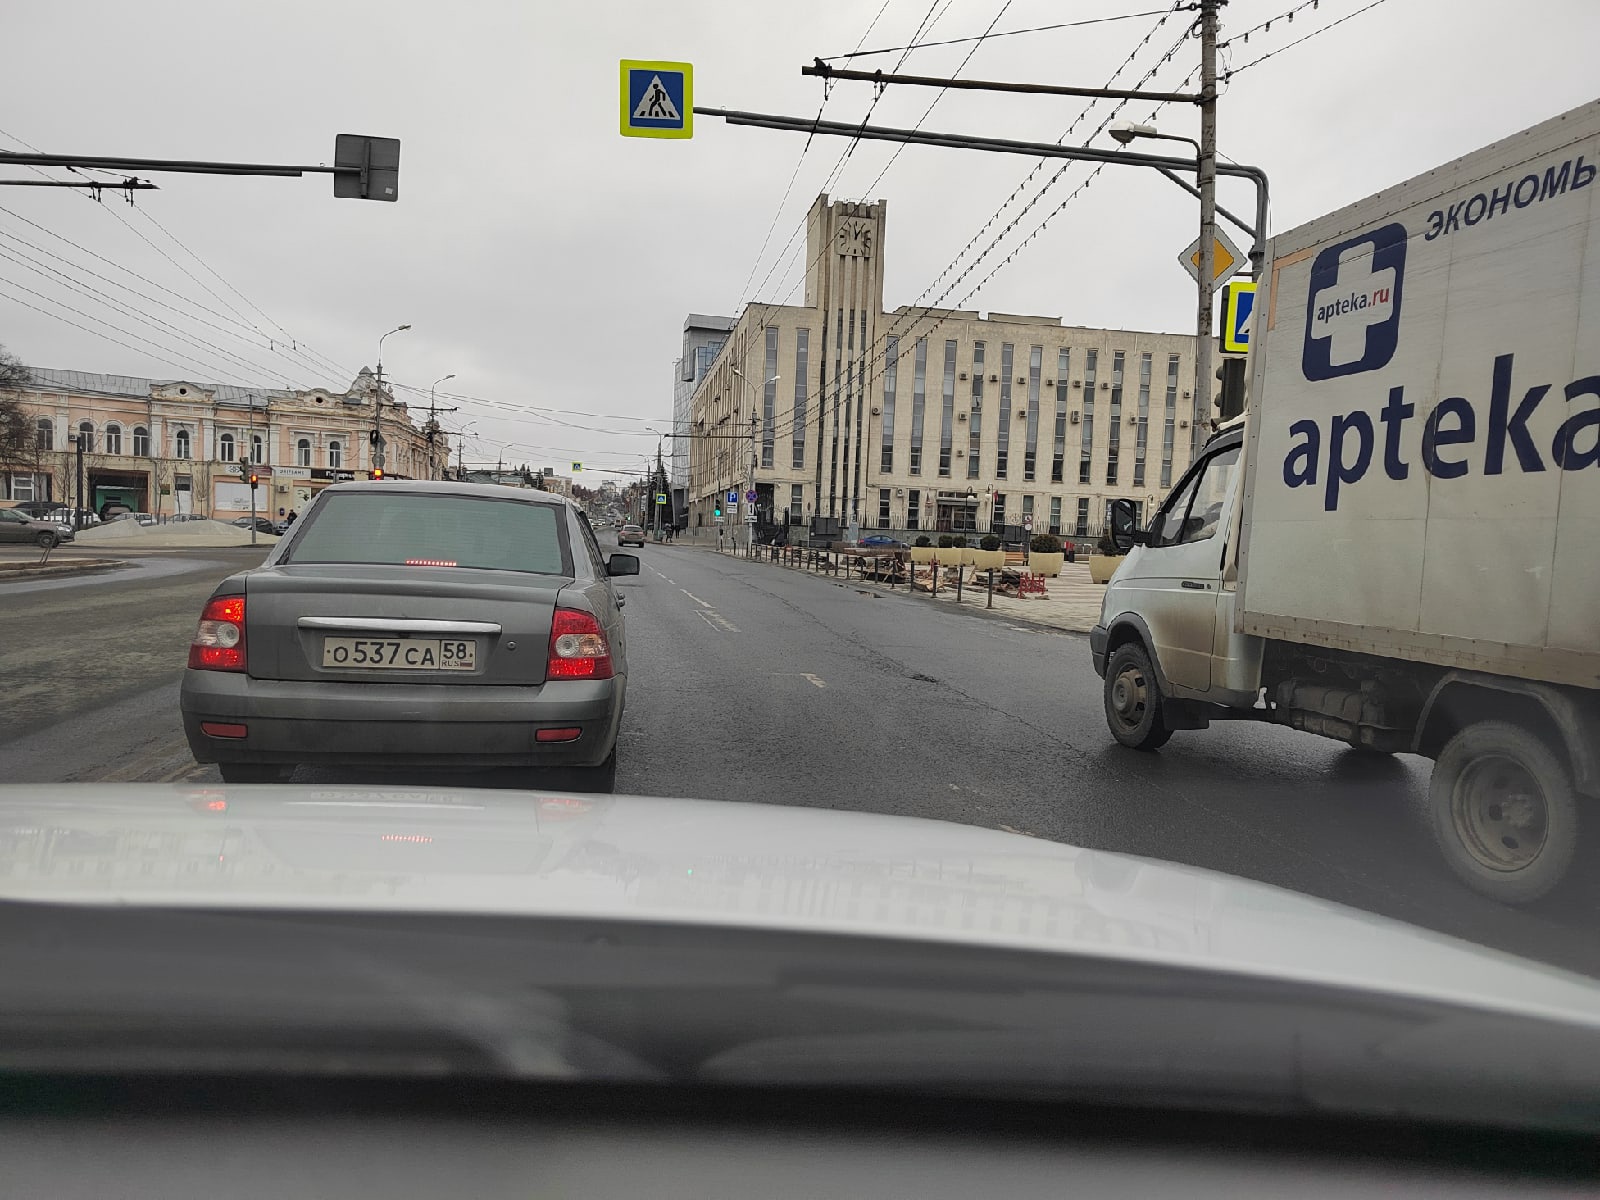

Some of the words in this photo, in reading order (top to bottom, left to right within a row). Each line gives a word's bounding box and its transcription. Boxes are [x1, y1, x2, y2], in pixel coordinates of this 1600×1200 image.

[1424, 155, 1597, 241] ЭКОНОМЬ
[1317, 286, 1390, 324] apteka.ru
[1282, 352, 1600, 512] apteka
[443, 642, 467, 660] 58
